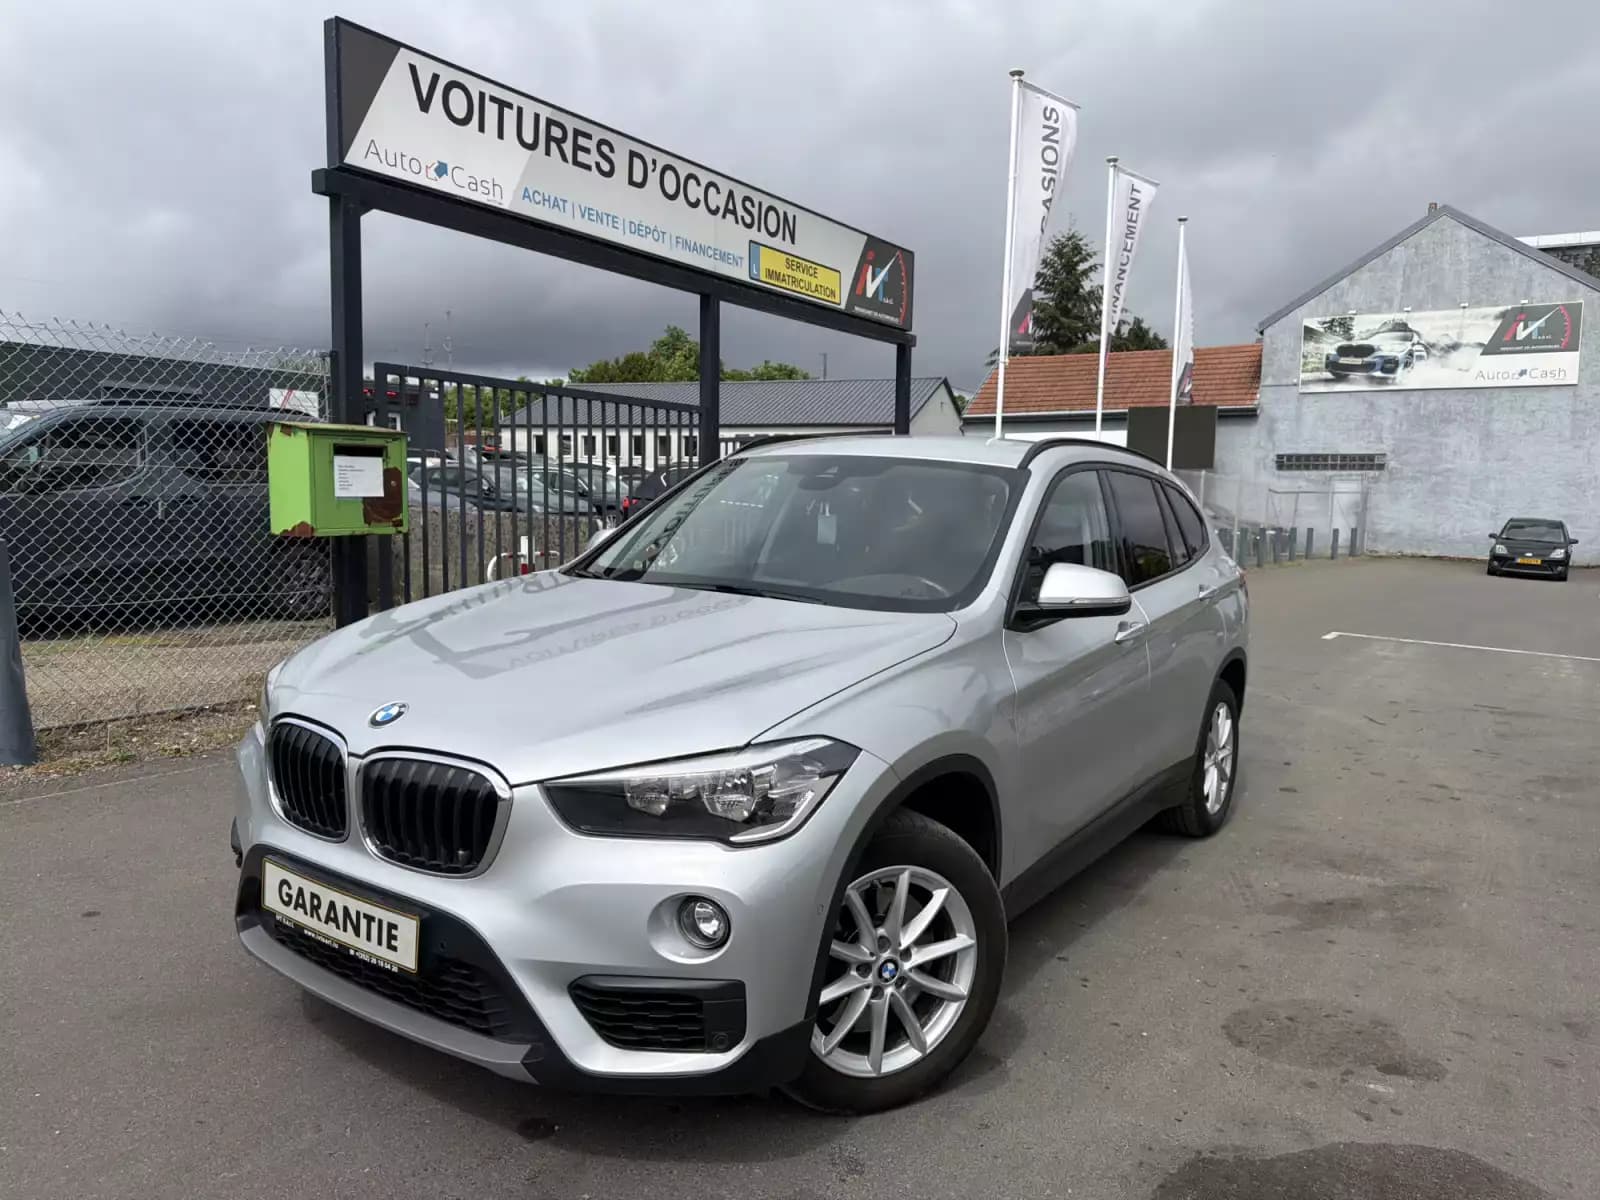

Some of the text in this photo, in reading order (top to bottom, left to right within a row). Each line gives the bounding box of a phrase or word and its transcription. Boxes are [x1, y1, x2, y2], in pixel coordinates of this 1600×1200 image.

[365, 139, 503, 200] Auto Cash
[408, 63, 796, 244] VOITURES D'OCCASION
[522, 186, 744, 268] ACHAT VENTE DÉPÔT FINANCEMENT
[753, 264, 758, 274] L
[765, 268, 836, 299] IMMATRICULATION
[785, 258, 818, 278] SERVICE
[1529, 368, 1567, 379] Cash
[278, 878, 399, 952] GARANTIE
